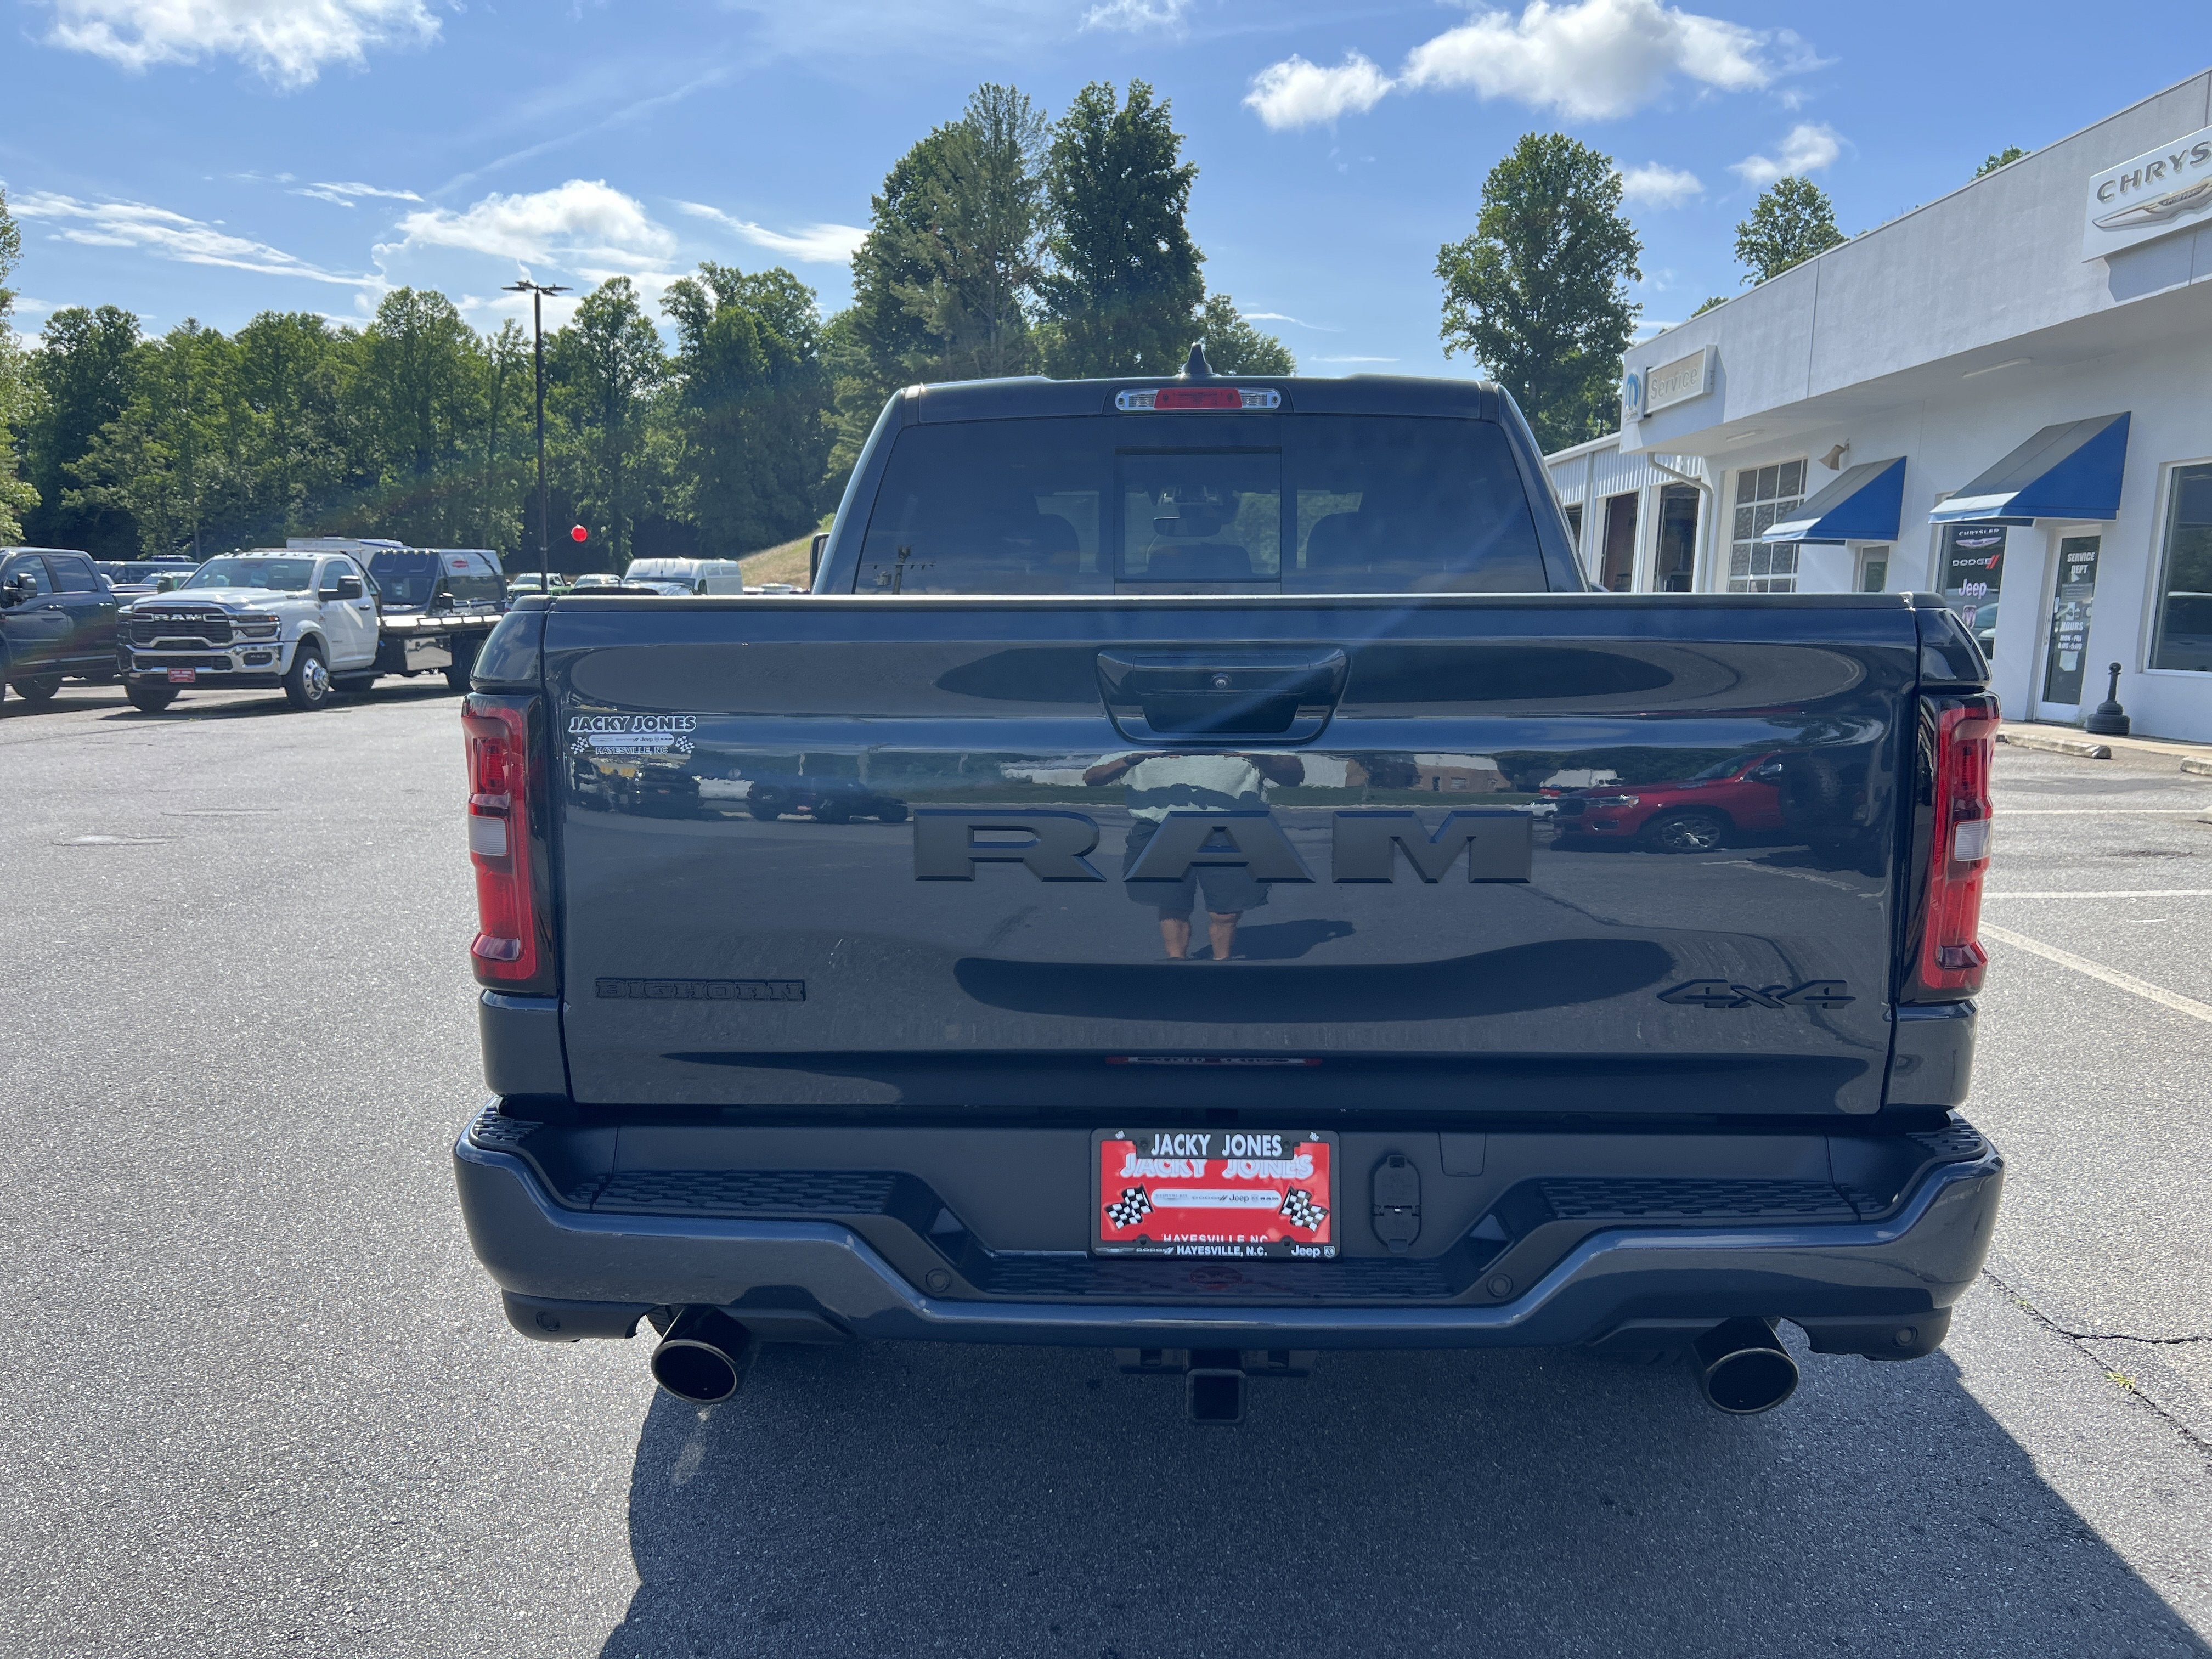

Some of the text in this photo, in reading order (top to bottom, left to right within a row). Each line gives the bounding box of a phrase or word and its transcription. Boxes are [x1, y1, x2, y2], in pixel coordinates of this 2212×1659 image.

[2097, 140, 2212, 202] CHRYS
[1651, 368, 1698, 400] Service
[1959, 528, 2000, 536] CHRYSLER
[1952, 557, 1993, 567] DODGE
[2067, 552, 2095, 563] SERVICE
[2071, 564, 2089, 574] DEPT
[1959, 578, 1987, 600] Jeep
[2059, 622, 2084, 632] HOURS
[568, 715, 697, 733] JACKY JONES
[595, 747, 653, 755] HAYESVILLE,
[913, 809, 1532, 883] RAM
[1150, 1133, 1282, 1157] JACKY JONES
[1120, 1152, 1314, 1179] JACKY JONES
[1229, 1194, 1249, 1203] Jeep
[1176, 1245, 1244, 1257] HAYESVILLE,
[1246, 1245, 1268, 1256] N.C.
[1291, 1245, 1321, 1257] Jeep
